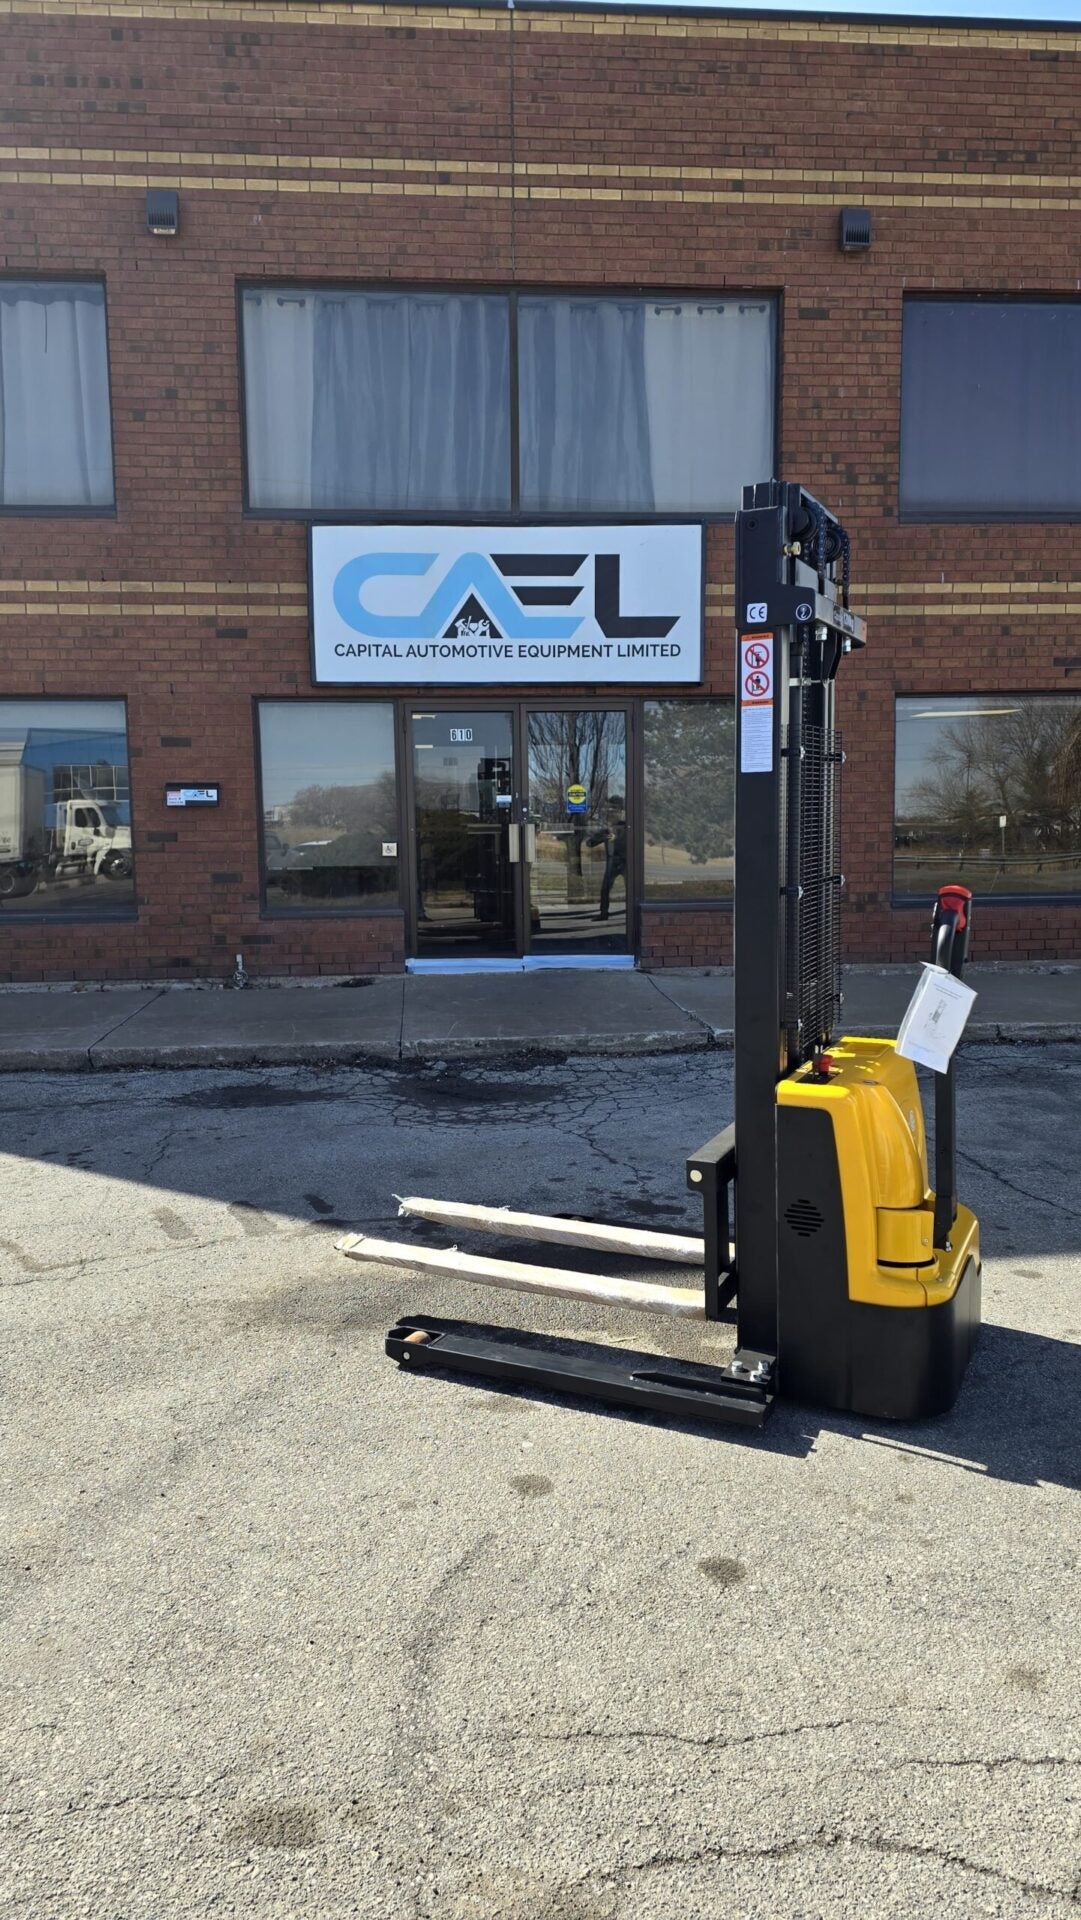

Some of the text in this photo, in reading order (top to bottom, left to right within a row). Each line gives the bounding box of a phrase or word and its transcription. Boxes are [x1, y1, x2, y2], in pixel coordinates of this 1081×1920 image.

[333, 551, 681, 638] CAEL
[749, 606, 766, 620] CE
[334, 643, 681, 658] CAPITAL AUTOMOTIVE EQUIPMENT LIMITED
[451, 729, 472, 741] 610
